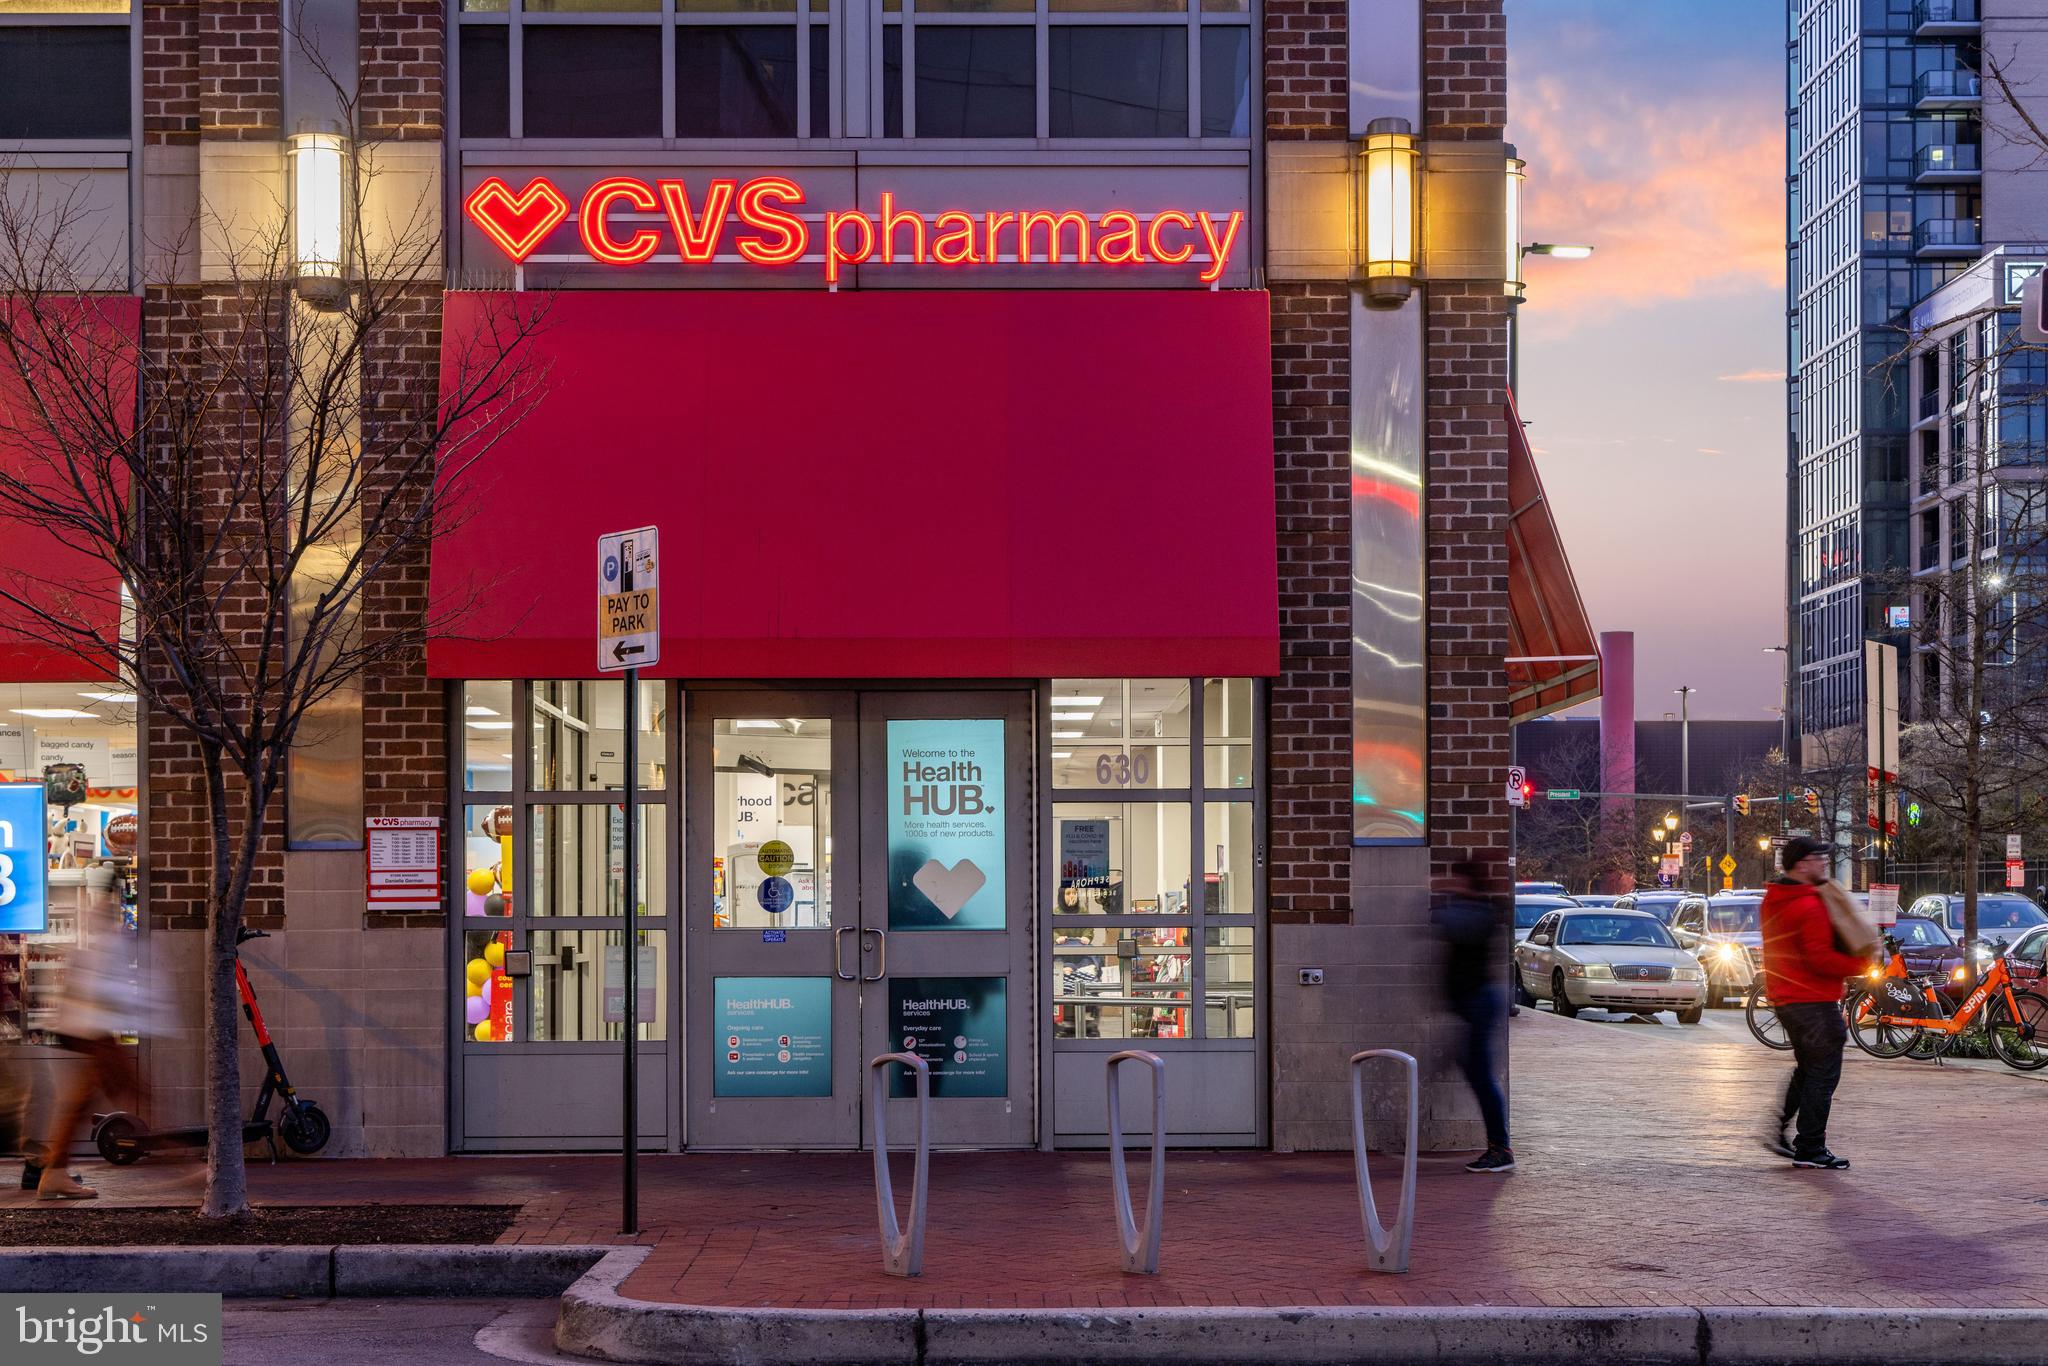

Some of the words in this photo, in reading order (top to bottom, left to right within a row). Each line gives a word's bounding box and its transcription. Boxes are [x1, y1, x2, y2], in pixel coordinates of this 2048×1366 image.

[578, 176, 810, 265] CVS
[825, 191, 1244, 282] pharmacy
[608, 596, 630, 614] PAY
[634, 594, 650, 610] TO
[612, 614, 644, 632] PARK
[40, 741, 69, 749] bagged
[71, 741, 94, 750] candy
[902, 749, 946, 758] Welcome
[904, 761, 982, 782] Health
[1096, 753, 1149, 784] 630
[958, 830, 995, 838] products.
[1963, 990, 1987, 1013] SPIN
